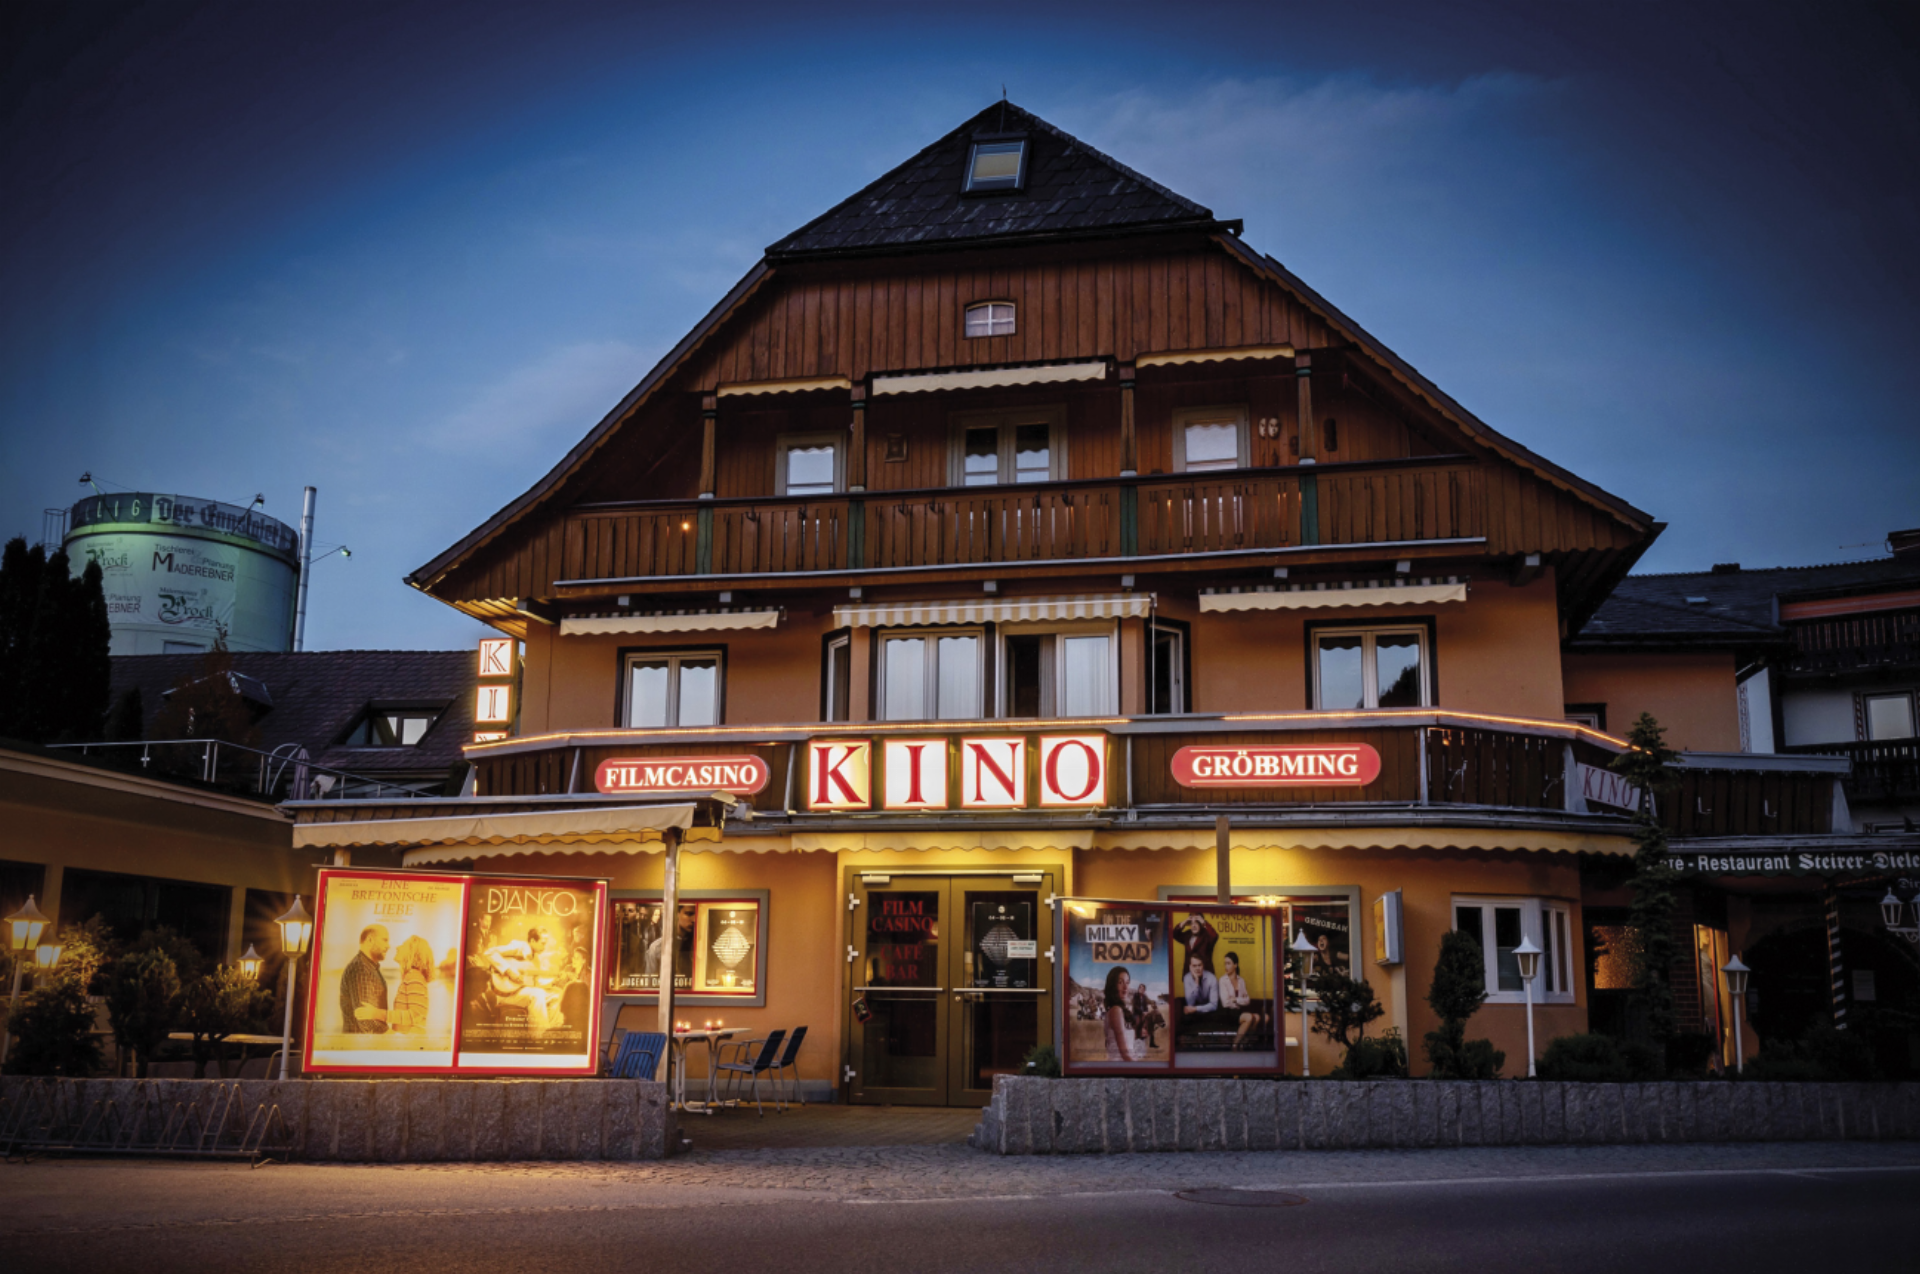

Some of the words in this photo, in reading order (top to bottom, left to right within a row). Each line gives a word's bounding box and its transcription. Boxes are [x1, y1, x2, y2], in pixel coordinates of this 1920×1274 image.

[155, 544, 195, 556] Tischlerei
[604, 764, 758, 788] FILMCASINO
[813, 739, 1100, 805] KINO
[1583, 767, 1634, 808] KINO
[1698, 855, 1791, 871] Restaurant
[351, 890, 438, 903] BRETONISCHE
[487, 888, 578, 917] DJANGO
[373, 902, 415, 916] LIEBE
[883, 900, 924, 915] FILM
[872, 916, 934, 932] CASINO
[1088, 926, 1137, 942] MILKY
[881, 941, 923, 961] CAFÉ
[1094, 942, 1151, 961] ROAD
[886, 964, 919, 980] BAR
